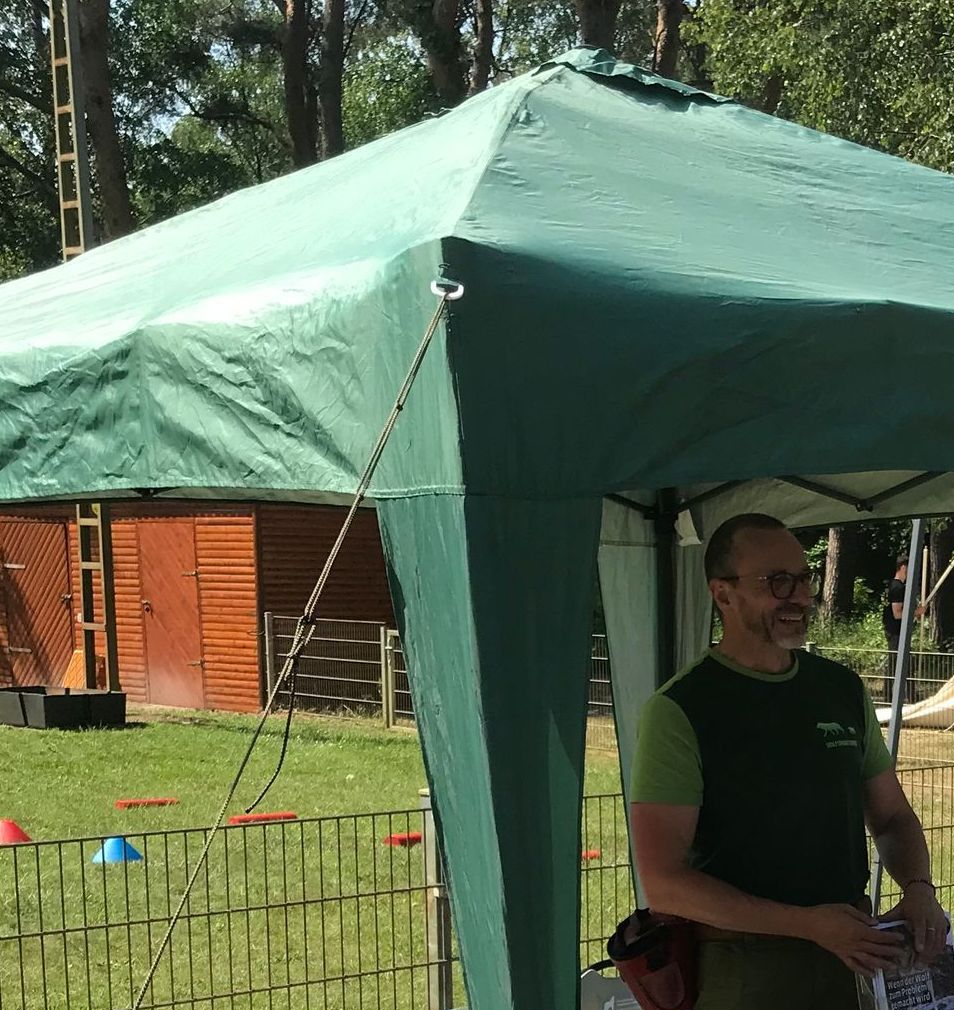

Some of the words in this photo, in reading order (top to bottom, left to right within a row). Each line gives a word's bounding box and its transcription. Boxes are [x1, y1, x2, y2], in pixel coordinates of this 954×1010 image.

[887, 979, 904, 989] Wenn
[905, 976, 914, 985] der
[915, 972, 929, 982] Wolf
[901, 983, 928, 996] Problem
[916, 992, 931, 1002] wird
